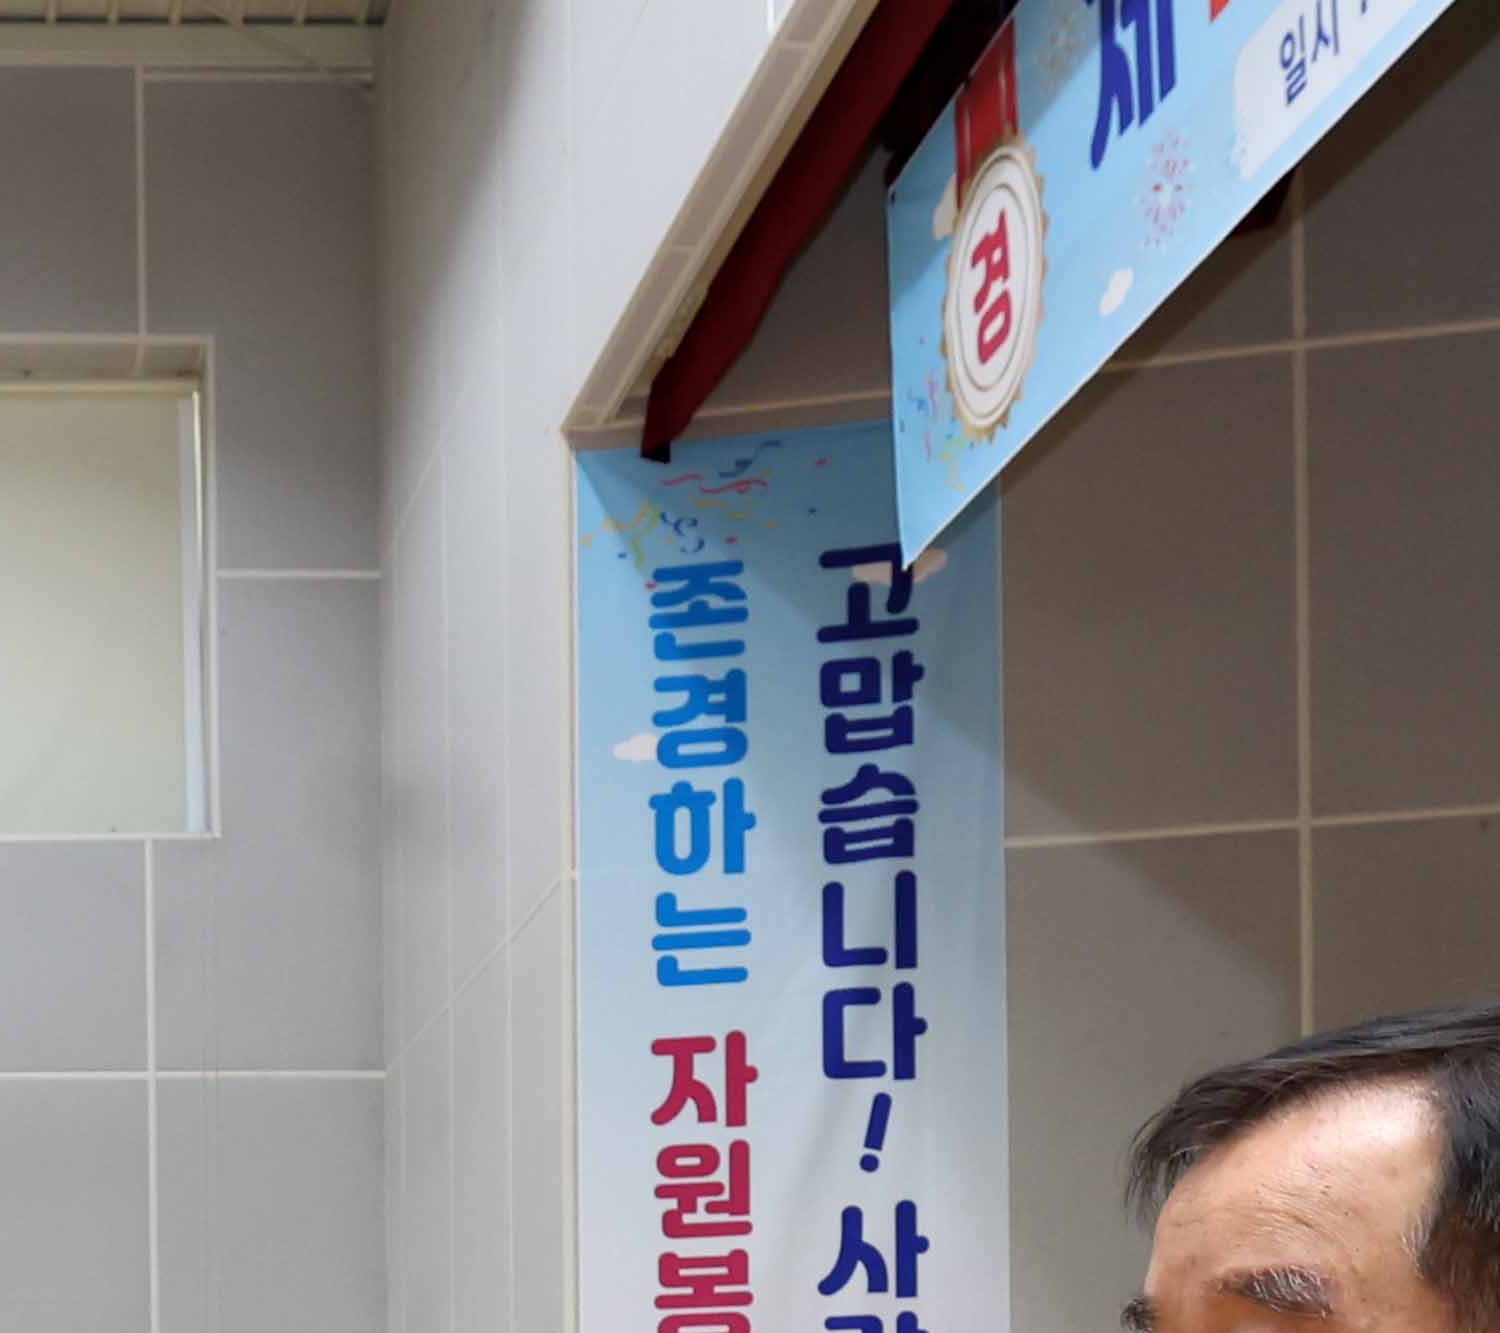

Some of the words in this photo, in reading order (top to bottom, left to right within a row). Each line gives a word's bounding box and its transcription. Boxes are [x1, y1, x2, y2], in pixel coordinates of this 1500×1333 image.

[971, 207, 1012, 365] 경
[648, 559, 756, 987] 존경하는
[817, 542, 928, 1172] 고맙습니다!
